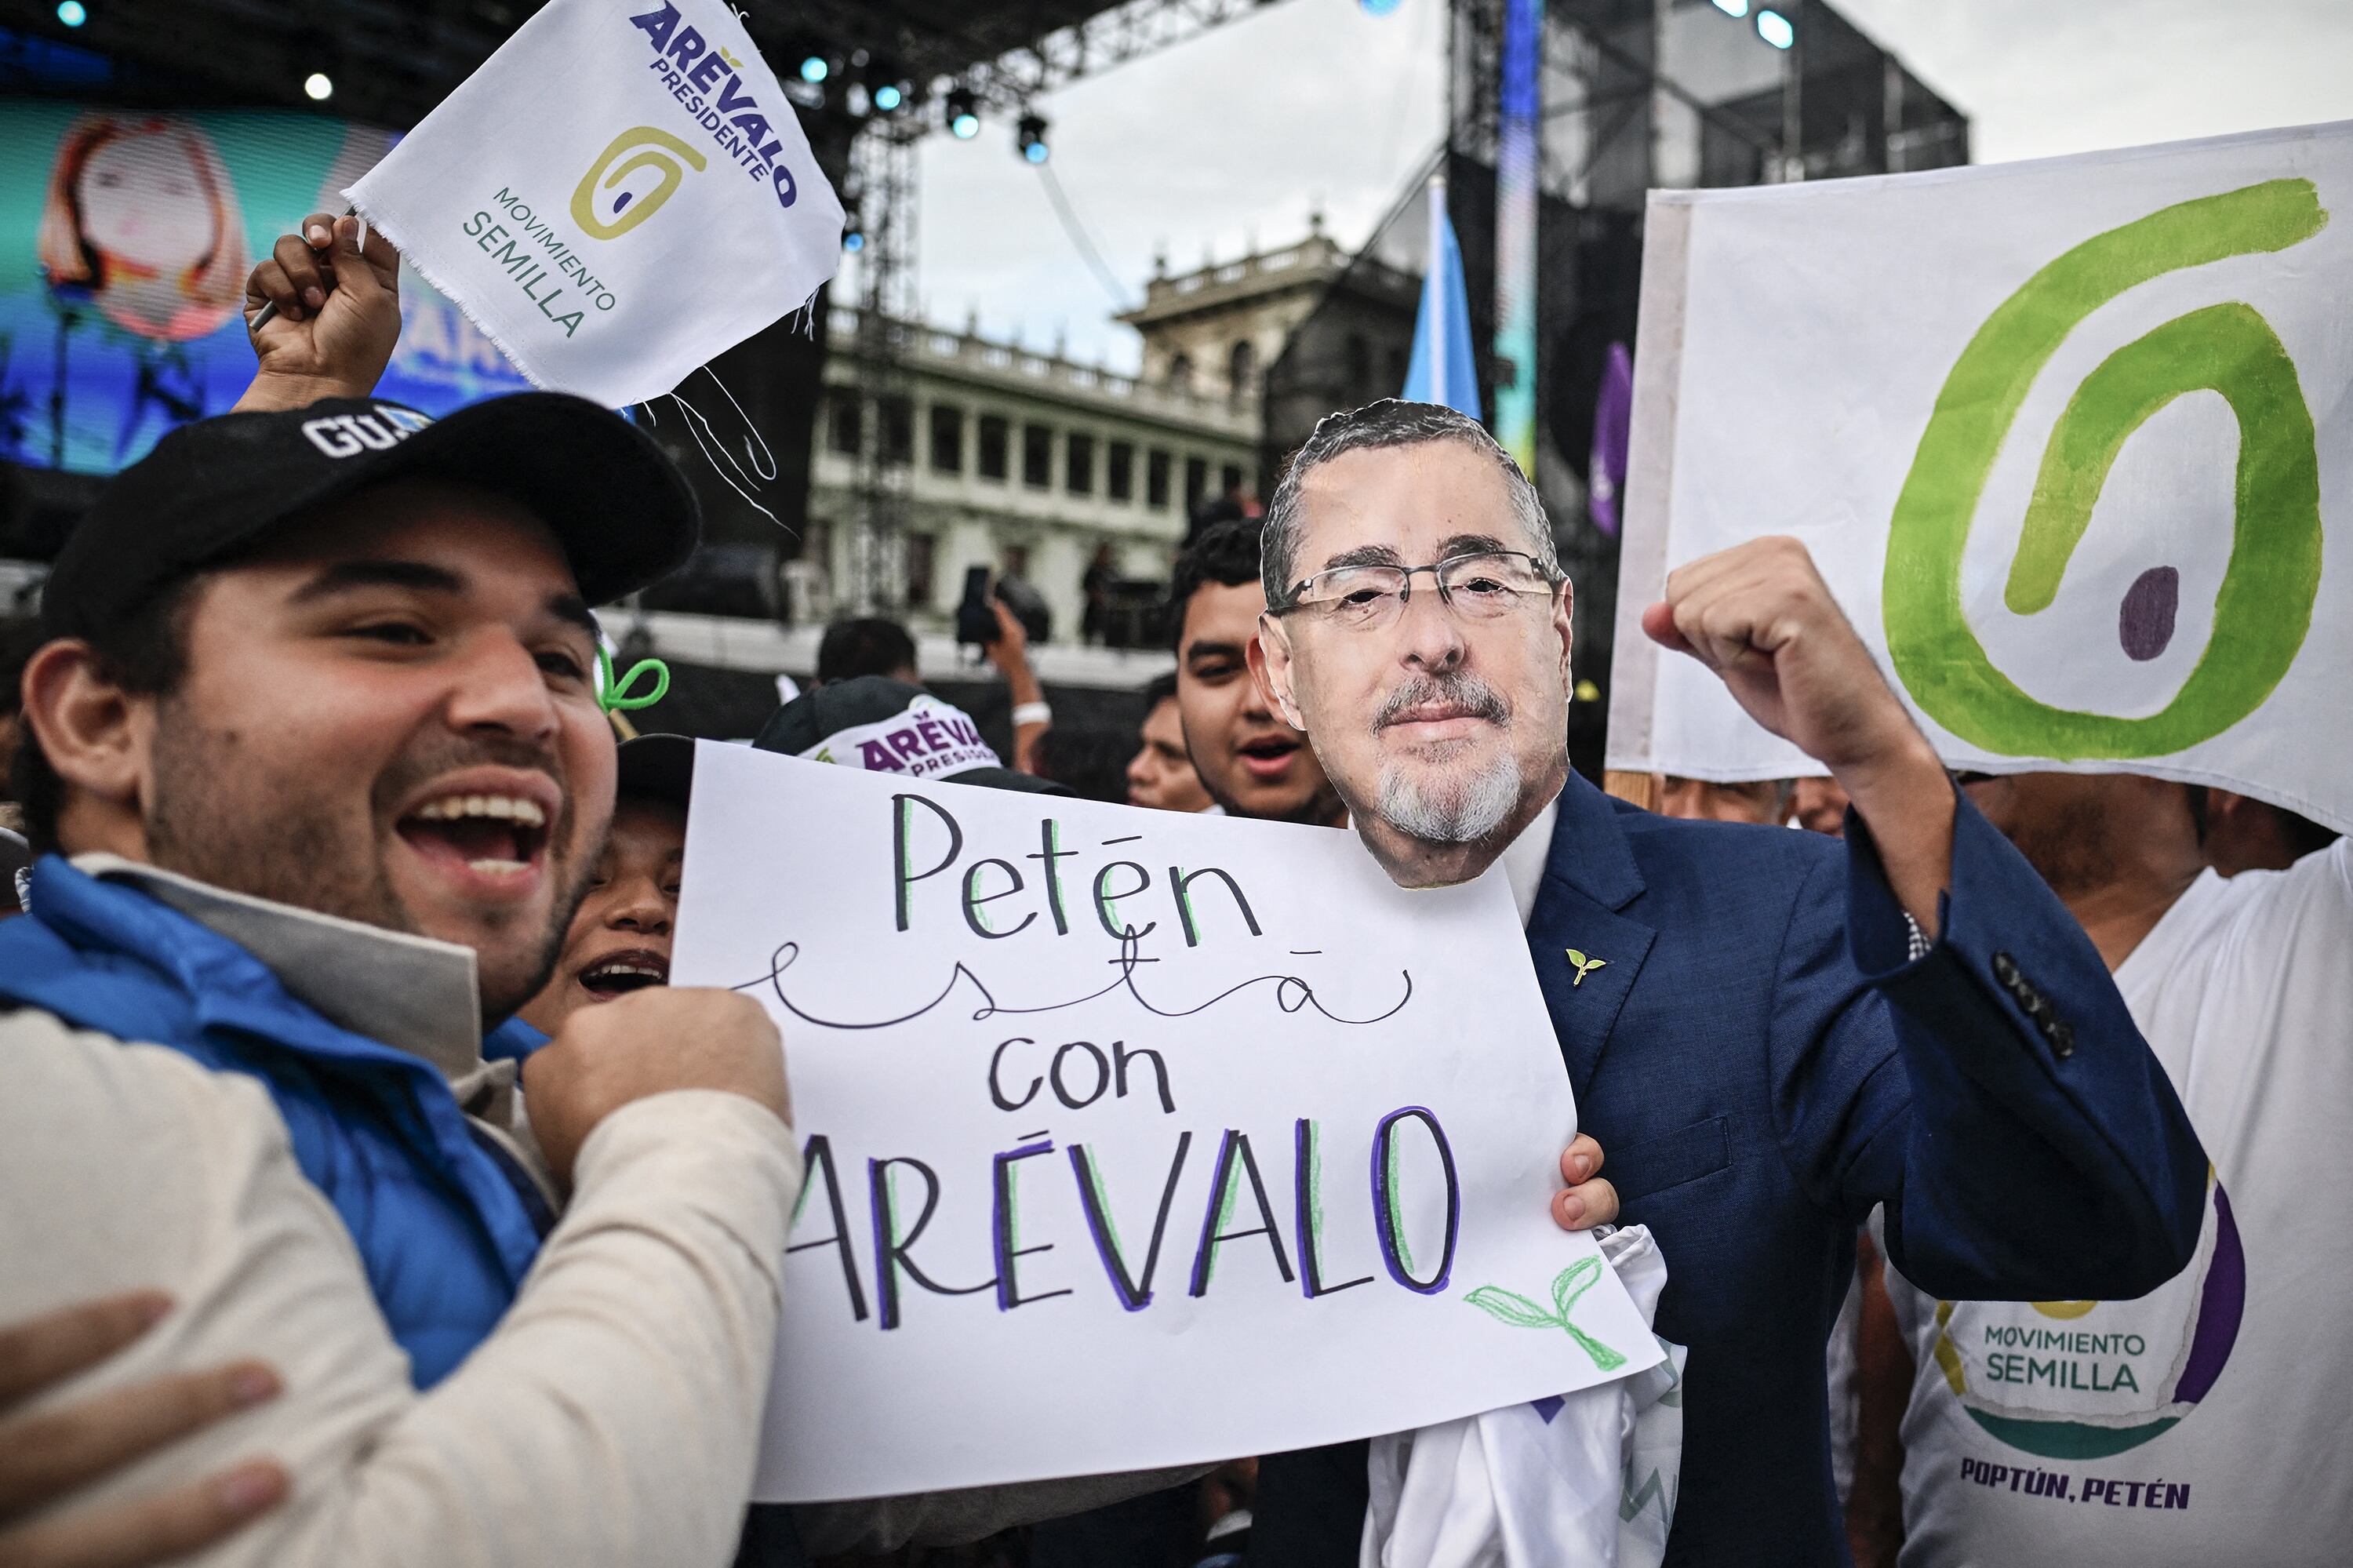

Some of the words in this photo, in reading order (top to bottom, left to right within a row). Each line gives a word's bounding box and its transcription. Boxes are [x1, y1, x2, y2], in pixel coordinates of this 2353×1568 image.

[649, 58, 769, 182] PRESIDENTE
[463, 211, 585, 339] SEMILLA
[493, 187, 616, 311] MOVIMIENTO
[892, 794, 1263, 948] Petén
[987, 1037, 1176, 1115] con
[785, 1104, 1460, 1330] ARÉVALO
[1985, 1326, 2146, 1356] MOVIMIENTO
[1987, 1353, 2140, 1394] SEMILLA
[1961, 1457, 2075, 1504] POPTÚN,
[2081, 1478, 2191, 1510] PETÉN
